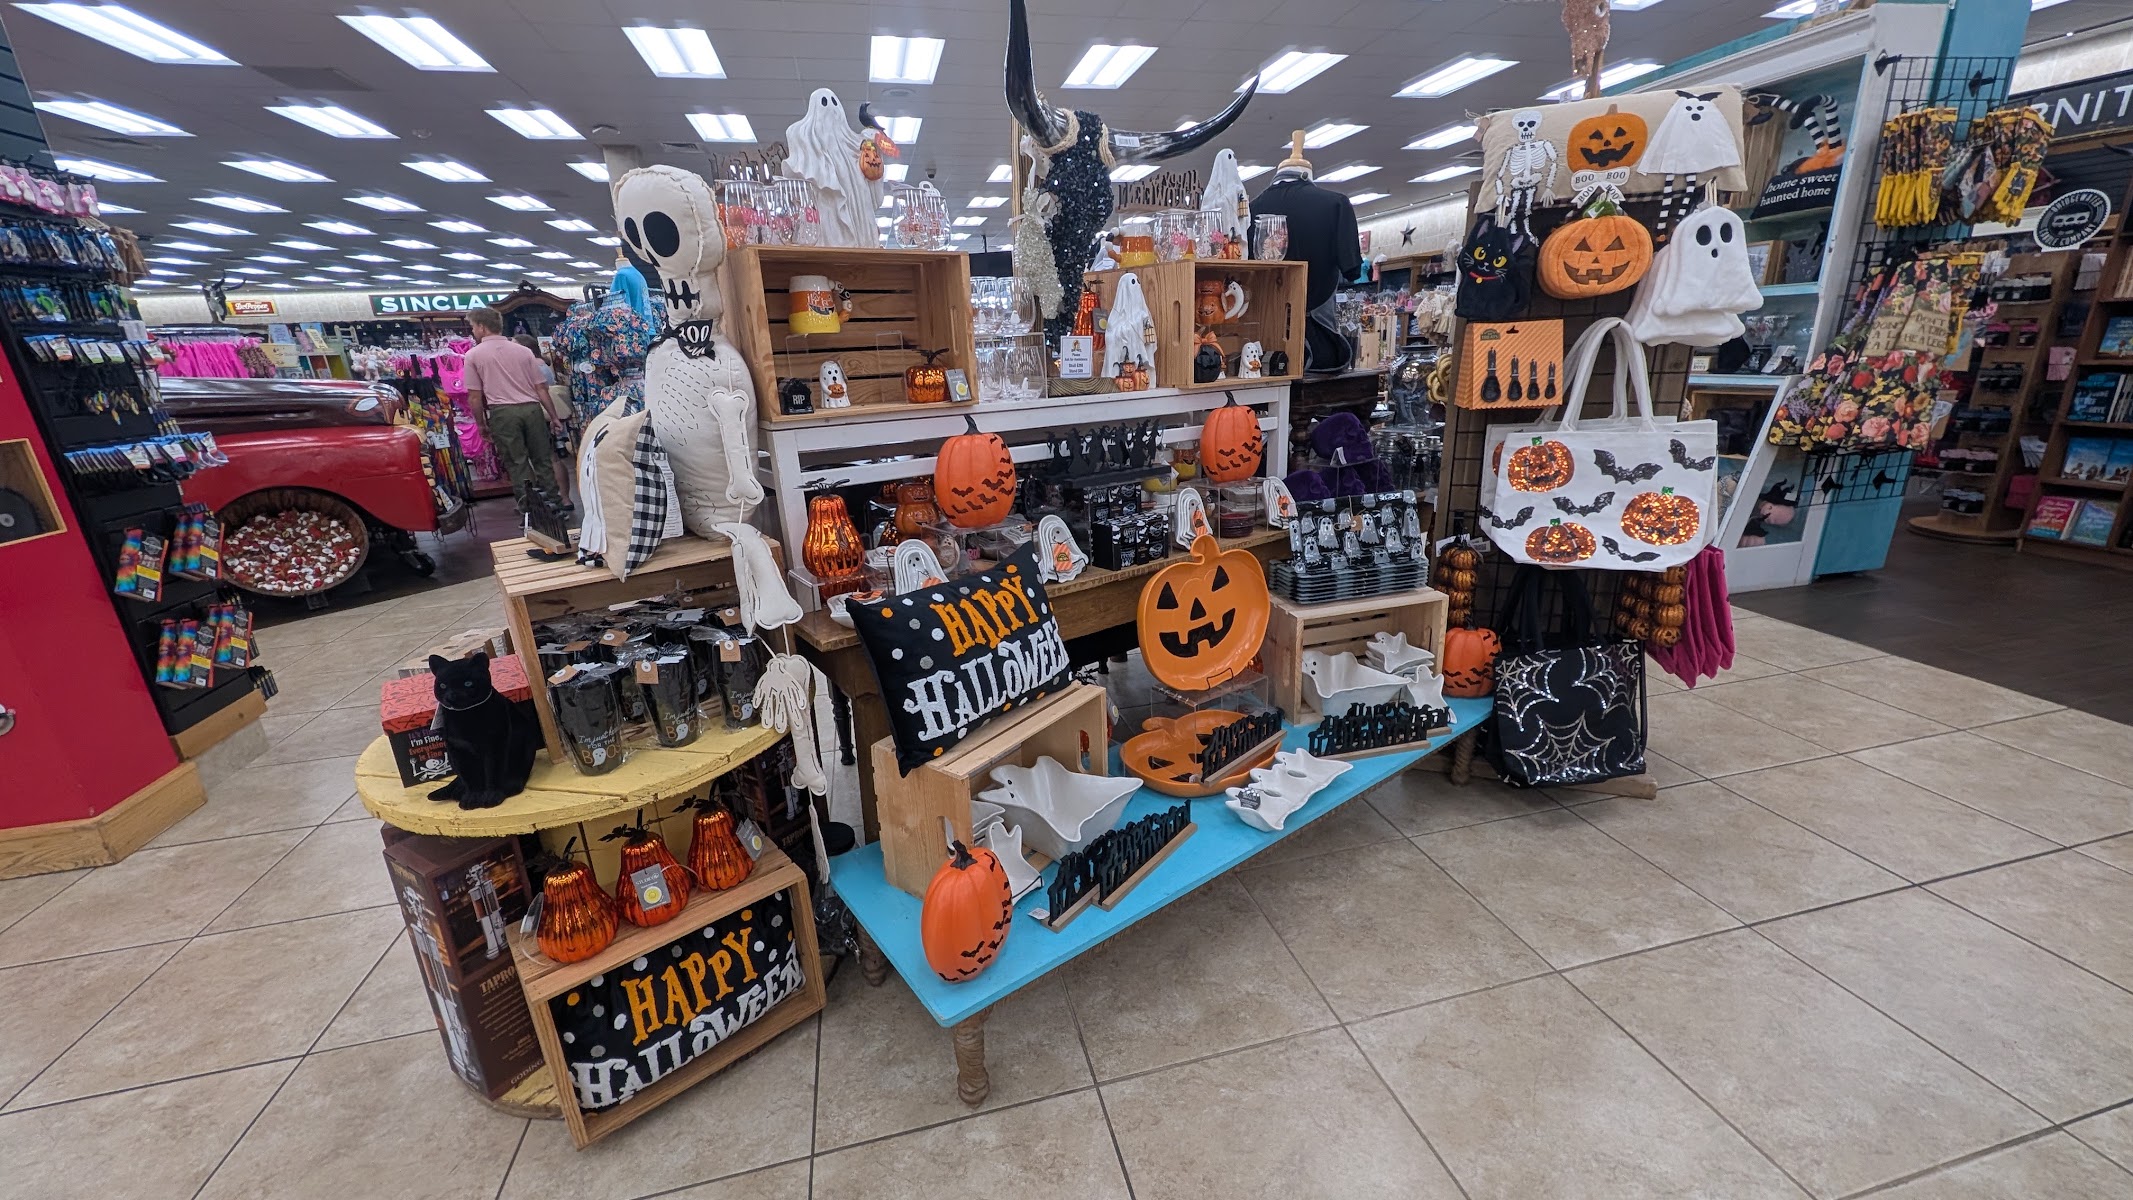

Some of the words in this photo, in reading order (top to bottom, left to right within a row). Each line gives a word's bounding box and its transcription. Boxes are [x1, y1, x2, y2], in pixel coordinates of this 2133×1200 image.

[1575, 174, 1595, 184] BOO
[1606, 171, 1626, 180] BOO
[1765, 179, 1798, 194] home
[1799, 173, 1838, 185] sweet
[1578, 185, 1595, 203] BOO
[1760, 187, 1800, 207] haunted
[1800, 186, 1831, 198] home
[2050, 193, 2104, 213] BRIDGEWATER
[2059, 223, 2096, 246] COMPANY
[792, 394, 806, 405] RIP
[930, 576, 1038, 657] HAPPY
[903, 616, 1070, 742] HALLOWEEN
[410, 738, 423, 747] I'm
[424, 735, 443, 744] Fine,
[578, 735, 592, 744] I'm
[587, 742, 602, 750] FOR
[604, 738, 616, 746] THE
[620, 927, 758, 1046] HAPPY
[569, 939, 807, 1109] HALLOWEEN
